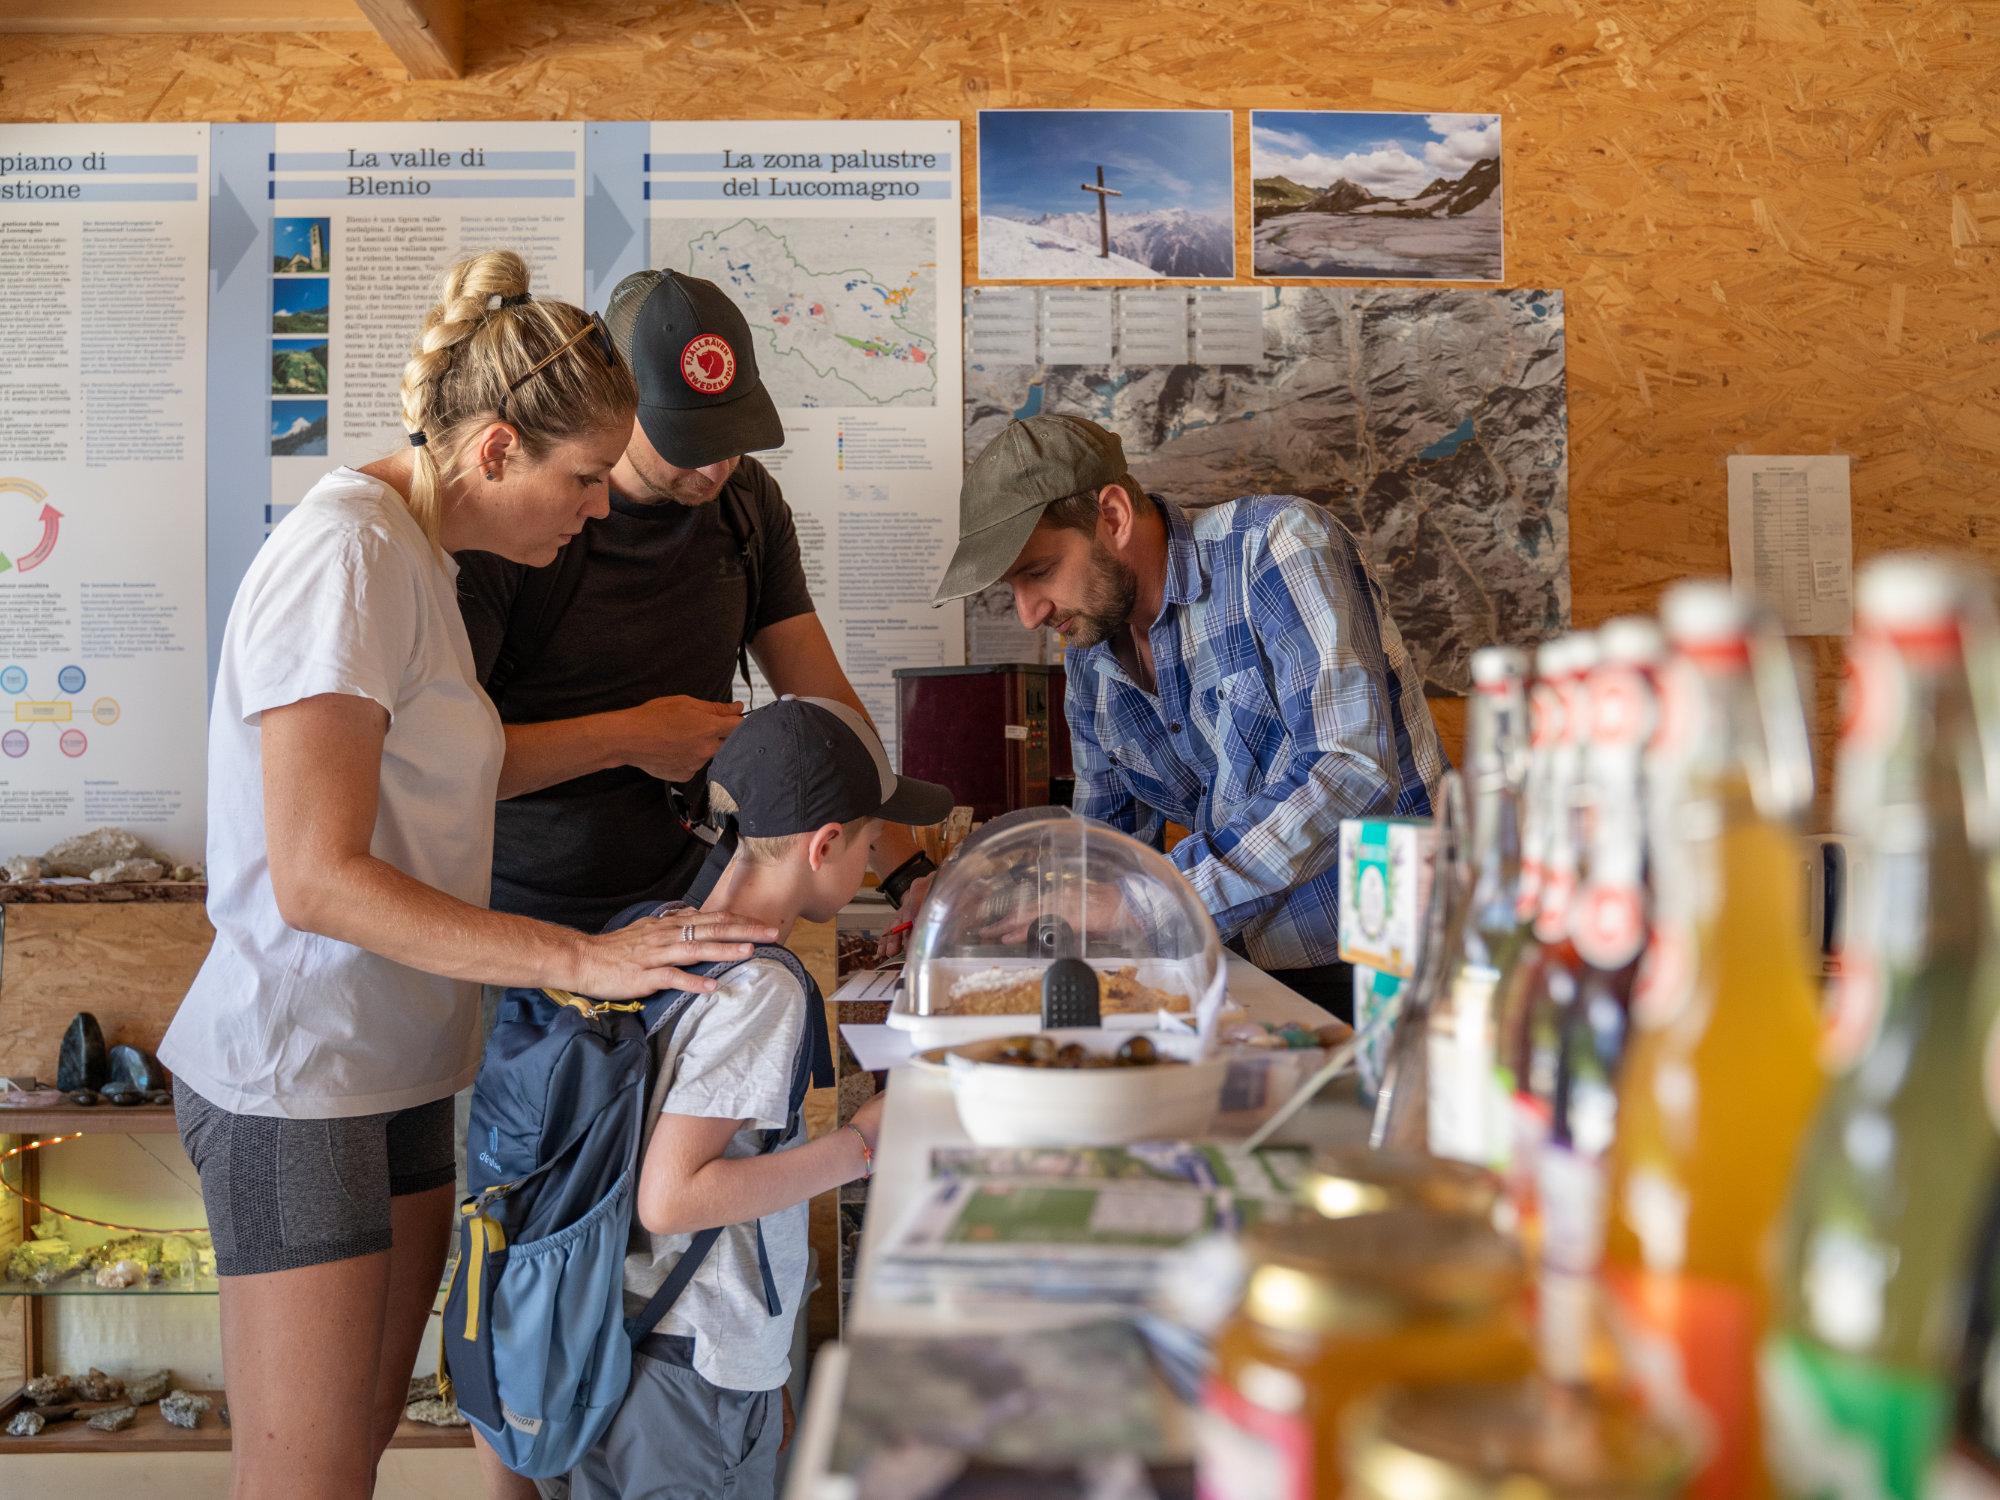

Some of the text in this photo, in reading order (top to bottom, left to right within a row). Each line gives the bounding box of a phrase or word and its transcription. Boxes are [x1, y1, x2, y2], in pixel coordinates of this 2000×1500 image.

[0, 152, 107, 176] piano di
[346, 148, 486, 168] La valle di
[722, 149, 937, 174] La zona palustre
[0, 180, 81, 200] stione
[346, 176, 432, 196] Blenio
[722, 177, 921, 201] del Lucomagno
[685, 337, 730, 366] FJÄLLRÄVEN
[687, 360, 733, 390] SWEDEN 1960
